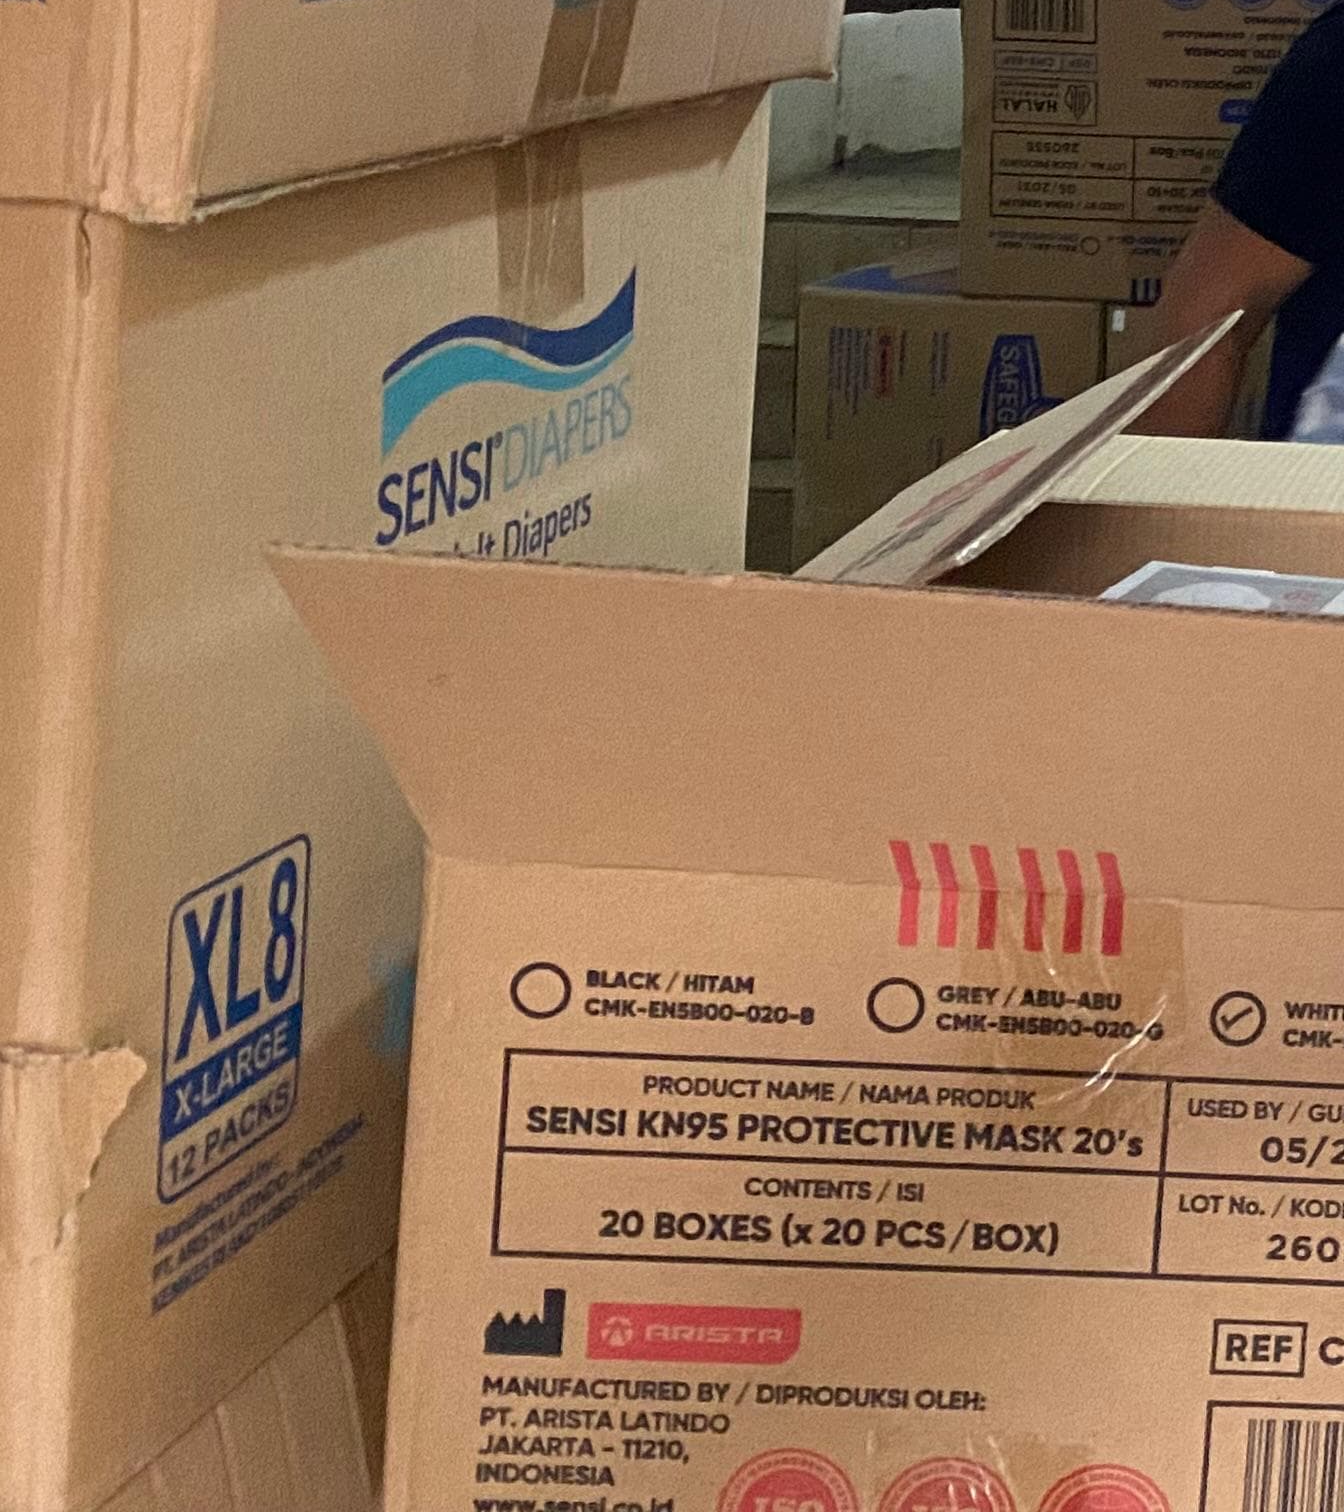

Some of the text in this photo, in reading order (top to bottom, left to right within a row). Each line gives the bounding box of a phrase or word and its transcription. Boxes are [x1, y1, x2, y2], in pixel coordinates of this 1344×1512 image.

[998, 98, 1058, 114] HALAL
[374, 374, 632, 547] SENSI DIAPERS
[503, 492, 593, 558] Diapers
[173, 856, 298, 1066] XL8
[585, 969, 755, 995] BLACK HITAM
[936, 985, 1122, 1012] GREY ABU-ABU
[172, 1019, 290, 1125] X-LARGE
[642, 1074, 1036, 1112] PRODUCT NAME NAMA PRODUK
[1187, 1097, 1248, 1120] USED
[1253, 1099, 1286, 1121] BY
[165, 1080, 291, 1188] 12 PACKS
[526, 1105, 1144, 1159] SENSI KN95 PROTECTIVE MASK 20's
[744, 1176, 924, 1203] CONTENTS ISI
[1178, 1191, 1222, 1215] LOT
[1227, 1194, 1266, 1217] No.
[598, 1209, 644, 1239] 20
[653, 1211, 772, 1244] BOXES
[780, 1213, 812, 1248] (x
[823, 1217, 867, 1248] 20
[643, 1324, 786, 1346] ARISTA
[1225, 1333, 1294, 1364] REF
[481, 1375, 987, 1412] MANUFACTURED BY DIPRODUKSI OLEH:
[478, 1407, 732, 1437] PT. ARISTA LATINDO
[477, 1434, 691, 1466] JAKARTA 11210,
[475, 1462, 616, 1488] INDONESIA
